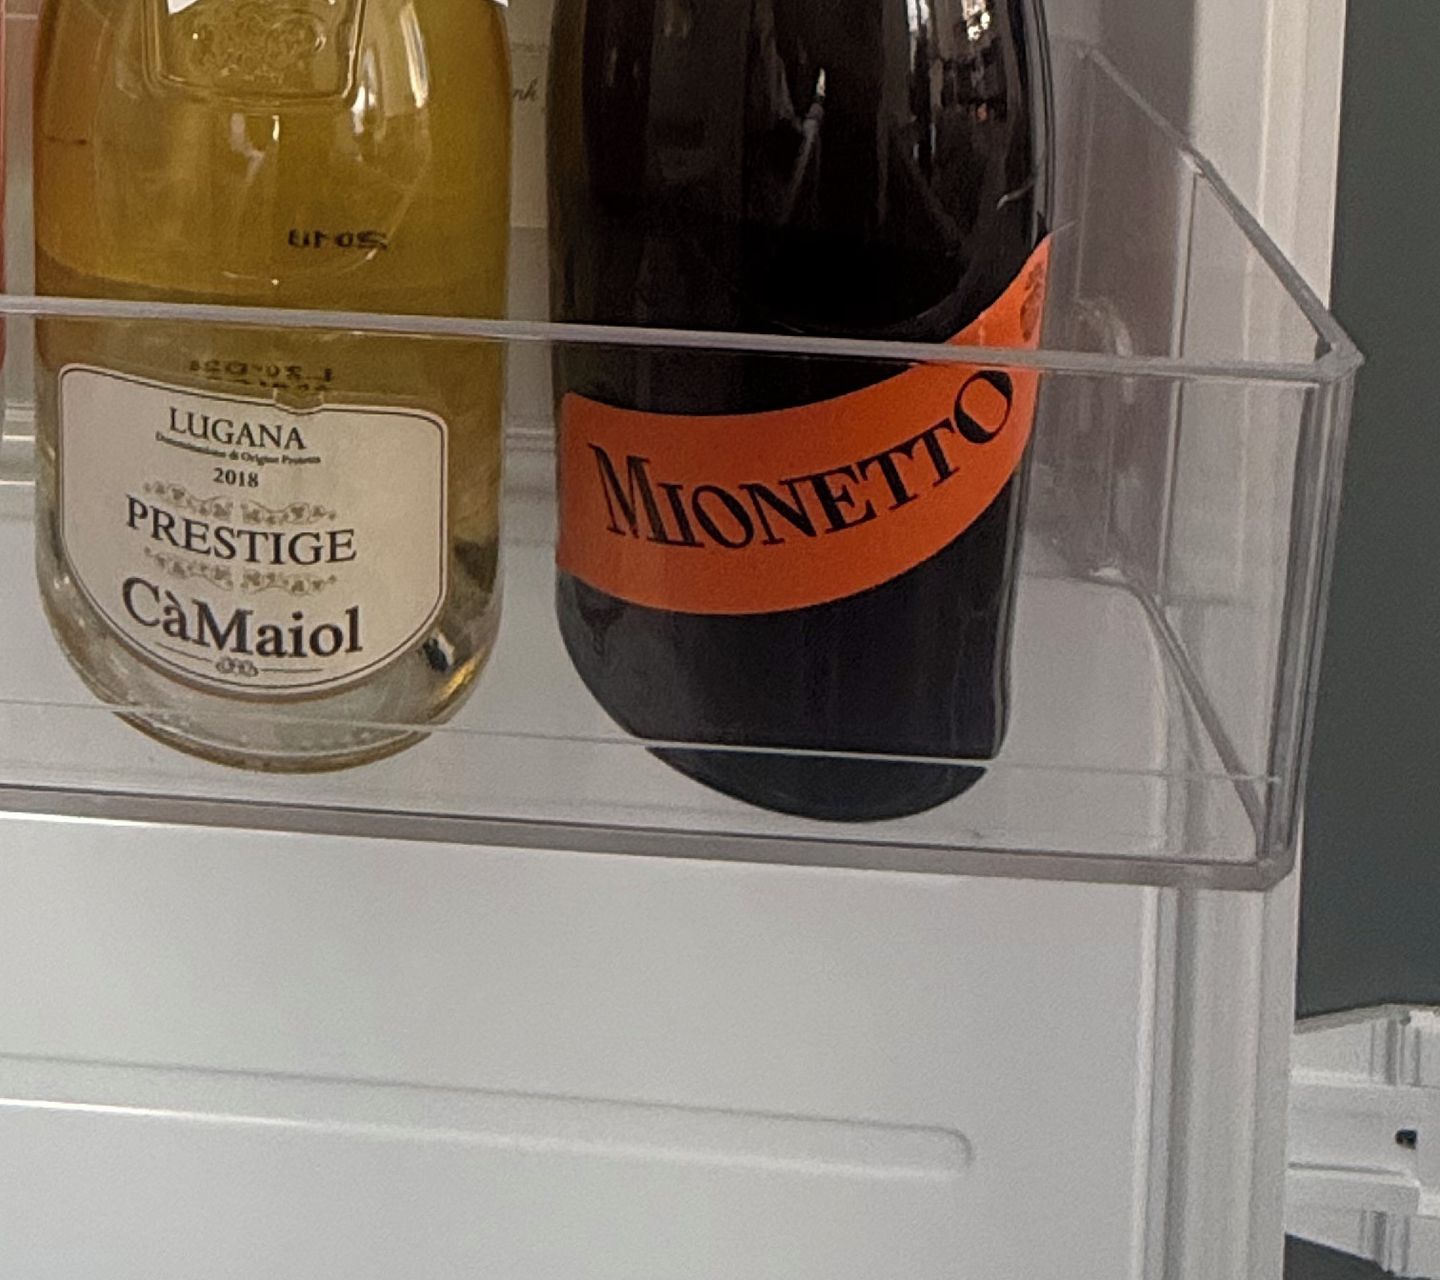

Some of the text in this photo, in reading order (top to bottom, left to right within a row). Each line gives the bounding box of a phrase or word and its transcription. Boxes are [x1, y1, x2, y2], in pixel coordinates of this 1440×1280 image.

[169, 407, 307, 450] LUGANA
[213, 467, 258, 488] 2018
[586, 369, 1013, 550] MIONETTO
[124, 494, 358, 567] PRESTIGE
